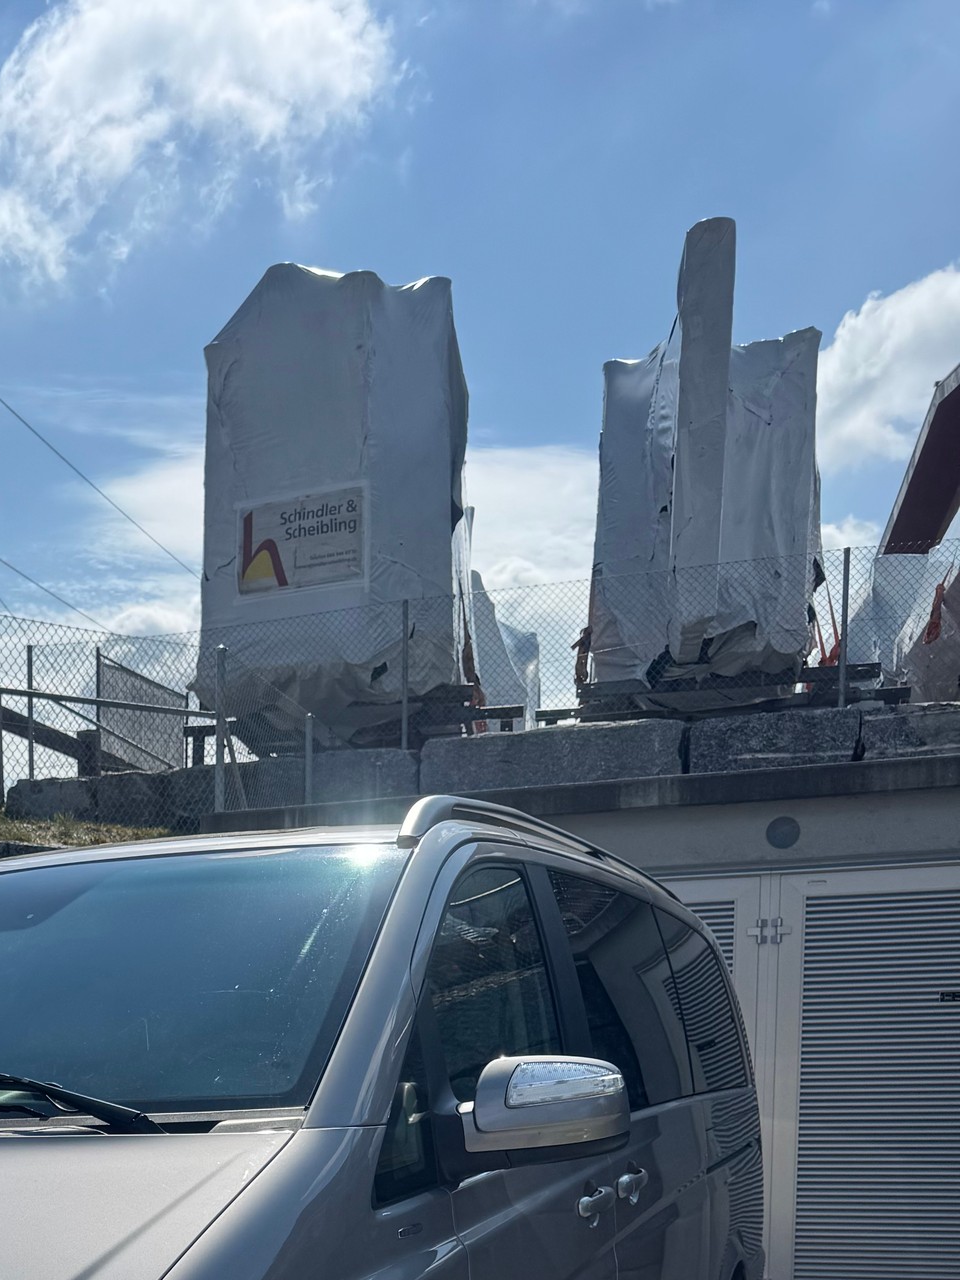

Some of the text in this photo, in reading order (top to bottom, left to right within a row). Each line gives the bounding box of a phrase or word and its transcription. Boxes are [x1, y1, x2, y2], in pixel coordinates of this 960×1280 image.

[280, 499, 358, 526] Schindler &
[285, 518, 358, 541] Scheibling
